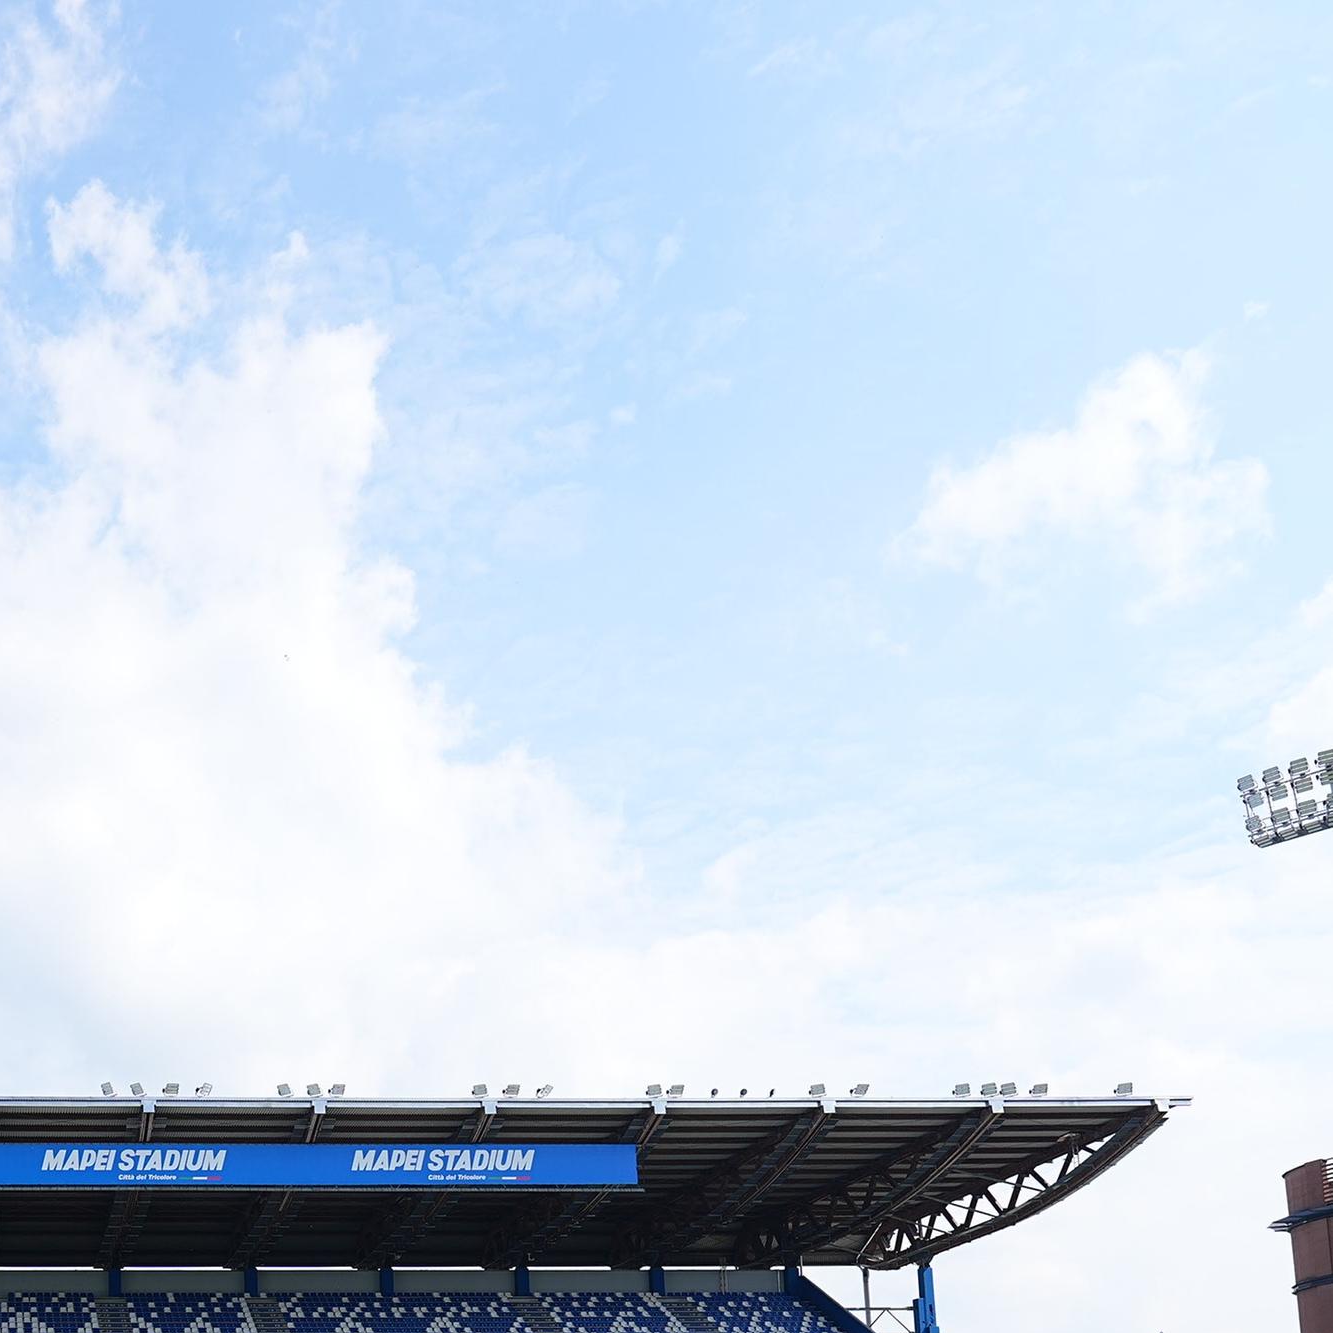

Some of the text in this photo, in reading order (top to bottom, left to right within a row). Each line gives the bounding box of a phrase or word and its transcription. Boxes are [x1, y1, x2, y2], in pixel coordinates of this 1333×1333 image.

[41, 1148, 227, 1171] MAPEI STADIUM
[351, 1148, 535, 1171] MAPEI STADIUM
[118, 1173, 176, 1181] Città del Tricolore
[428, 1173, 486, 1181] Città del Tricolore
